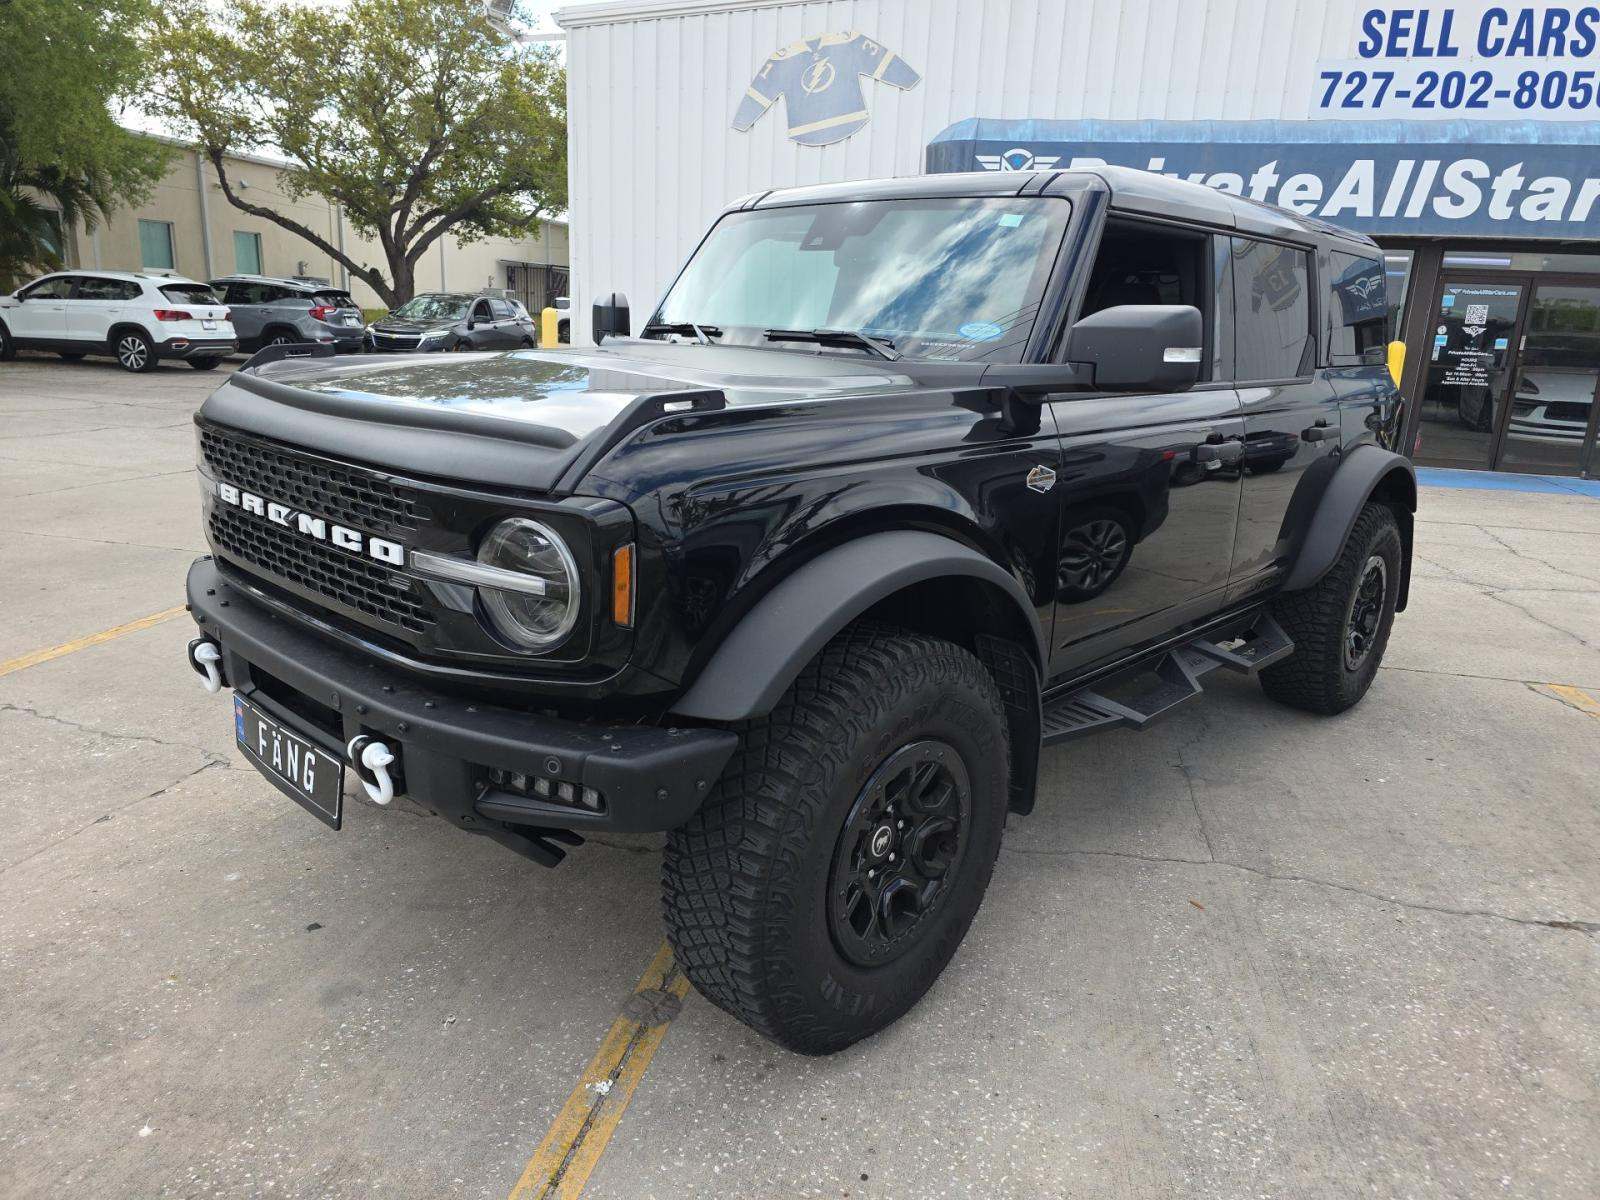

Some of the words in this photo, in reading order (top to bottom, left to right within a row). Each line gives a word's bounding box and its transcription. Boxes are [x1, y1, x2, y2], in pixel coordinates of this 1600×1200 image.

[1358, 9, 1459, 58] SELL
[1477, 7, 1600, 57] CARS
[1320, 70, 1600, 109] 727-202-805
[220, 482, 404, 566] BRONCO
[258, 720, 316, 793] FÄNG
